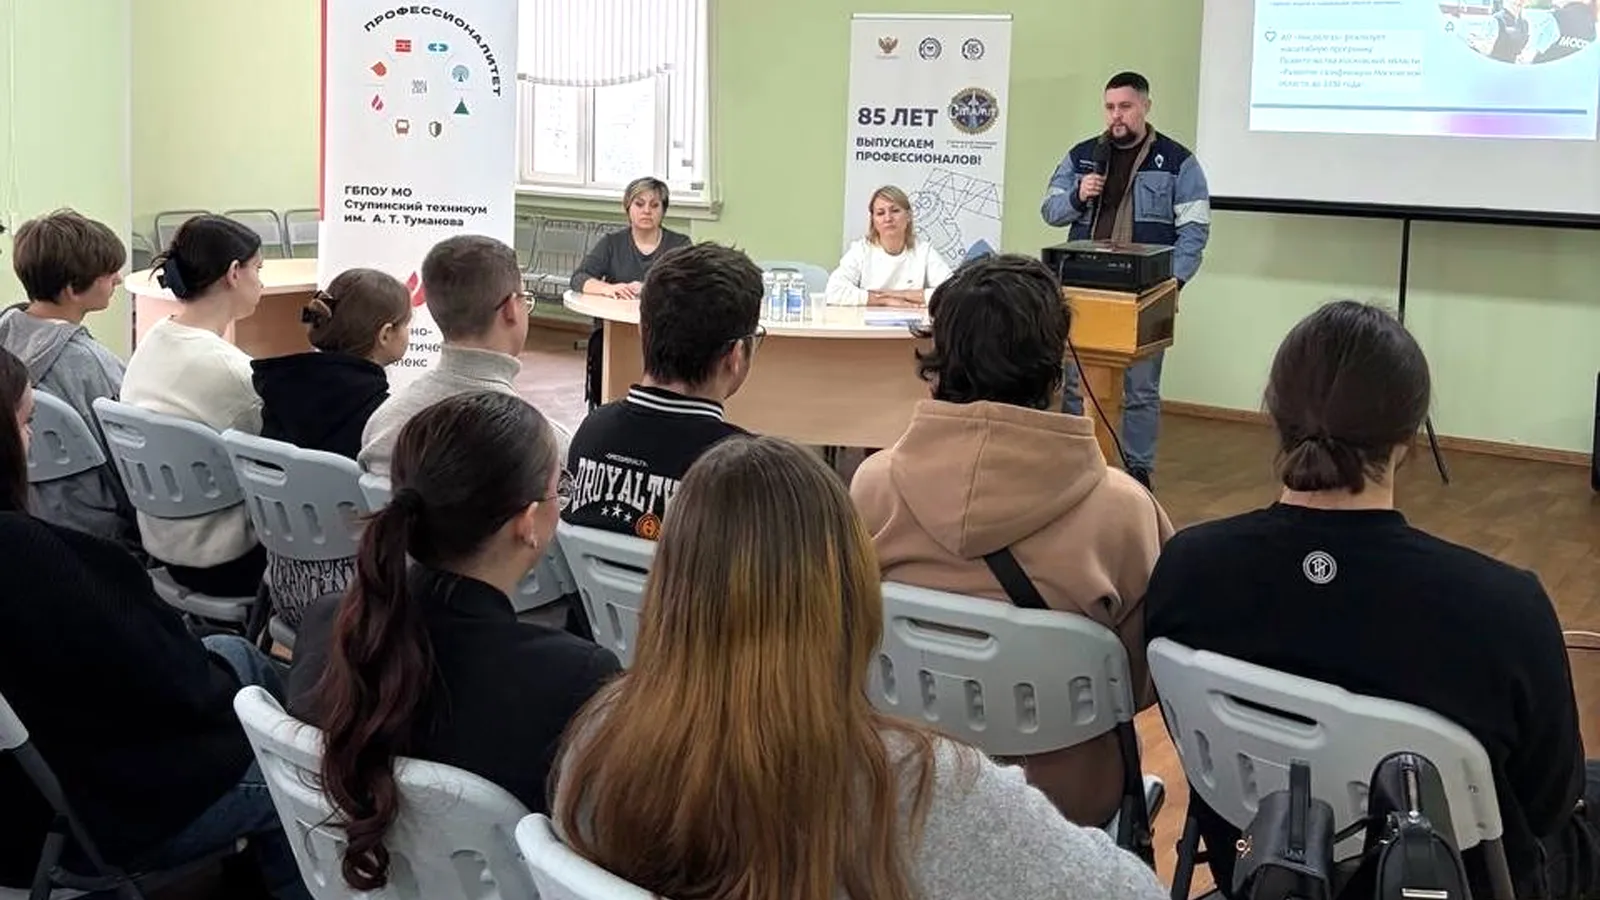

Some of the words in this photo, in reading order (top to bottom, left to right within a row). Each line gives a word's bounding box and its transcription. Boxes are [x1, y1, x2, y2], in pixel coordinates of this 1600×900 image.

[364, 6, 501, 97] ПРОФЕССИОНАЛИТЕТ
[857, 107, 886, 126] 85
[890, 108, 939, 127] ЛЕТ
[856, 137, 934, 149] ВЫПУСКАЕМ
[856, 151, 982, 165] ПРОФЕССИОНАЛОВ!
[344, 185, 388, 196] ГБПОУ
[391, 187, 412, 197] МО
[344, 199, 423, 211] Ступинский
[425, 203, 488, 216] техникум
[344, 214, 366, 223] им.
[372, 213, 386, 224] А.
[388, 214, 400, 225] Т.
[402, 215, 464, 227] Туманова
